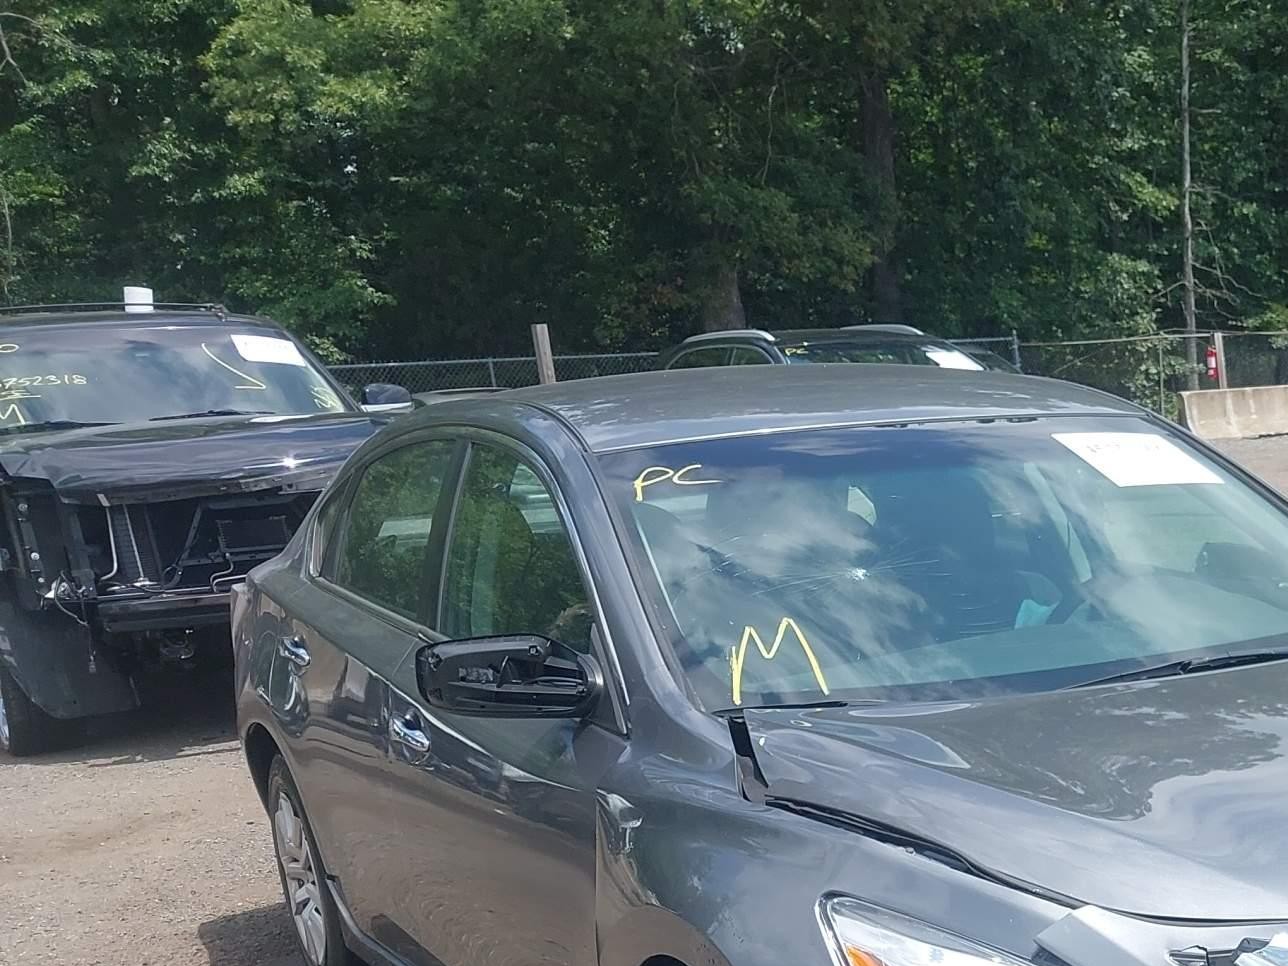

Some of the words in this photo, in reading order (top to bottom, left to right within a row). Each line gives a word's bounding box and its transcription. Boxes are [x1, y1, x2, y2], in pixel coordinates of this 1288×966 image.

[0, 374, 88, 390] 752318
[633, 463, 722, 503] PC
[729, 617, 830, 706] M
